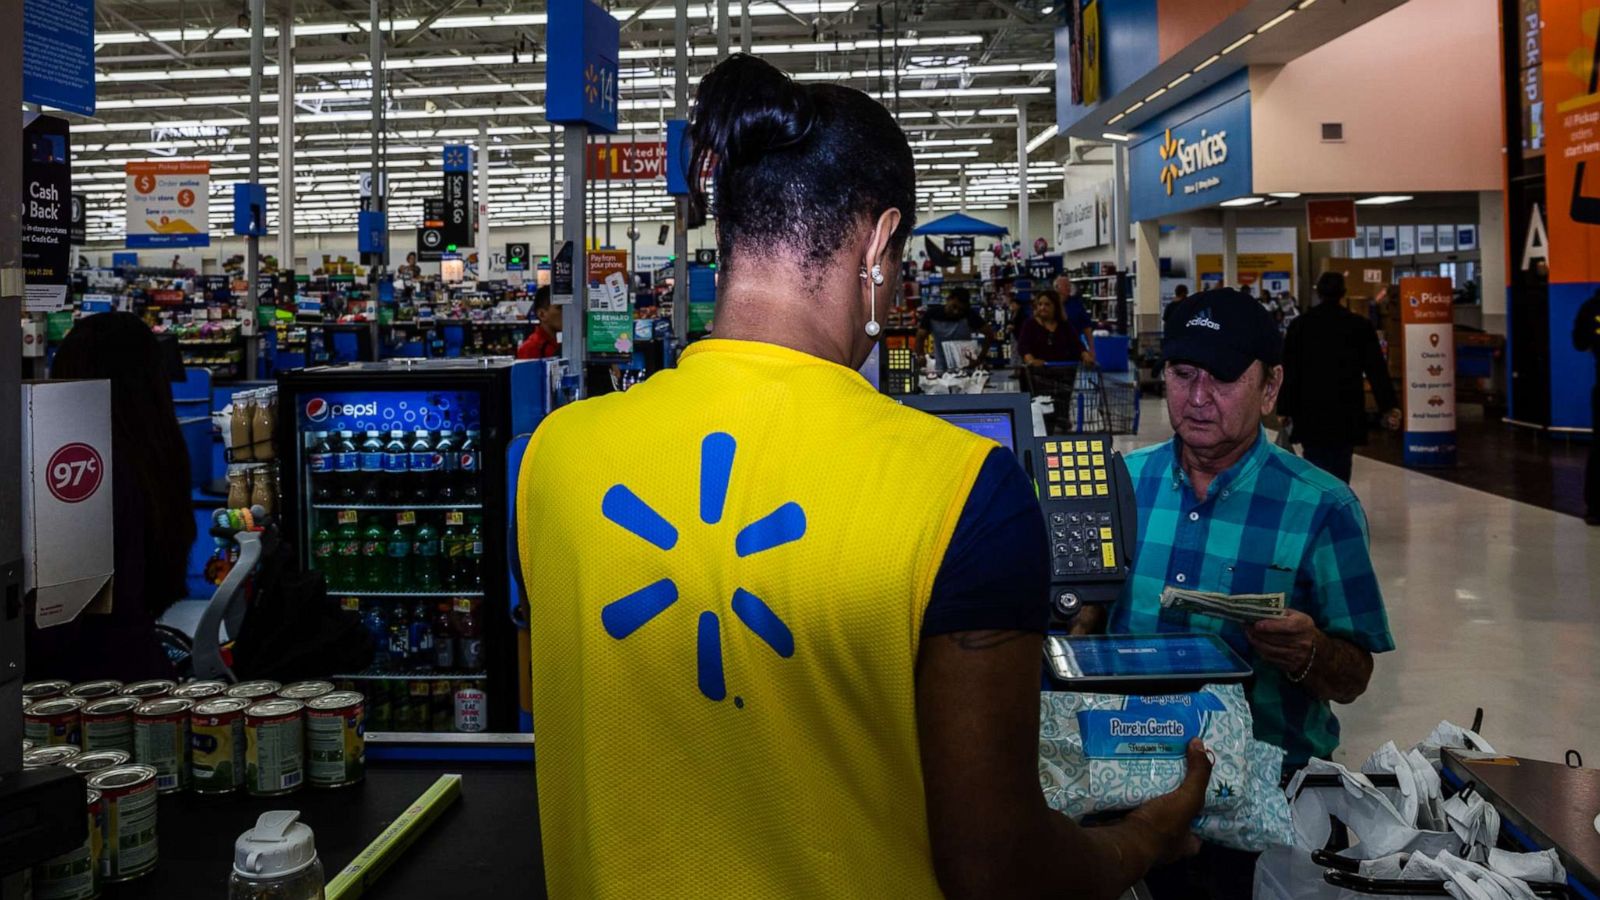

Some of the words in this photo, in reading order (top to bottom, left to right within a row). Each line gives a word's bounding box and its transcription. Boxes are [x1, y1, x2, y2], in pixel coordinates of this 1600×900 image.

[1525, 12, 1539, 101] Pickup
[600, 67, 614, 113] 14
[623, 147, 654, 157] Vted
[1177, 129, 1228, 177] Services
[29, 181, 59, 202] Cash
[453, 175, 464, 198] Scan
[29, 200, 60, 221] Back
[453, 208, 464, 224] Go
[1185, 317, 1221, 331] adidas
[331, 401, 377, 419] pepsi
[53, 456, 97, 489] 97¢
[1147, 717, 1184, 737] Gentle
